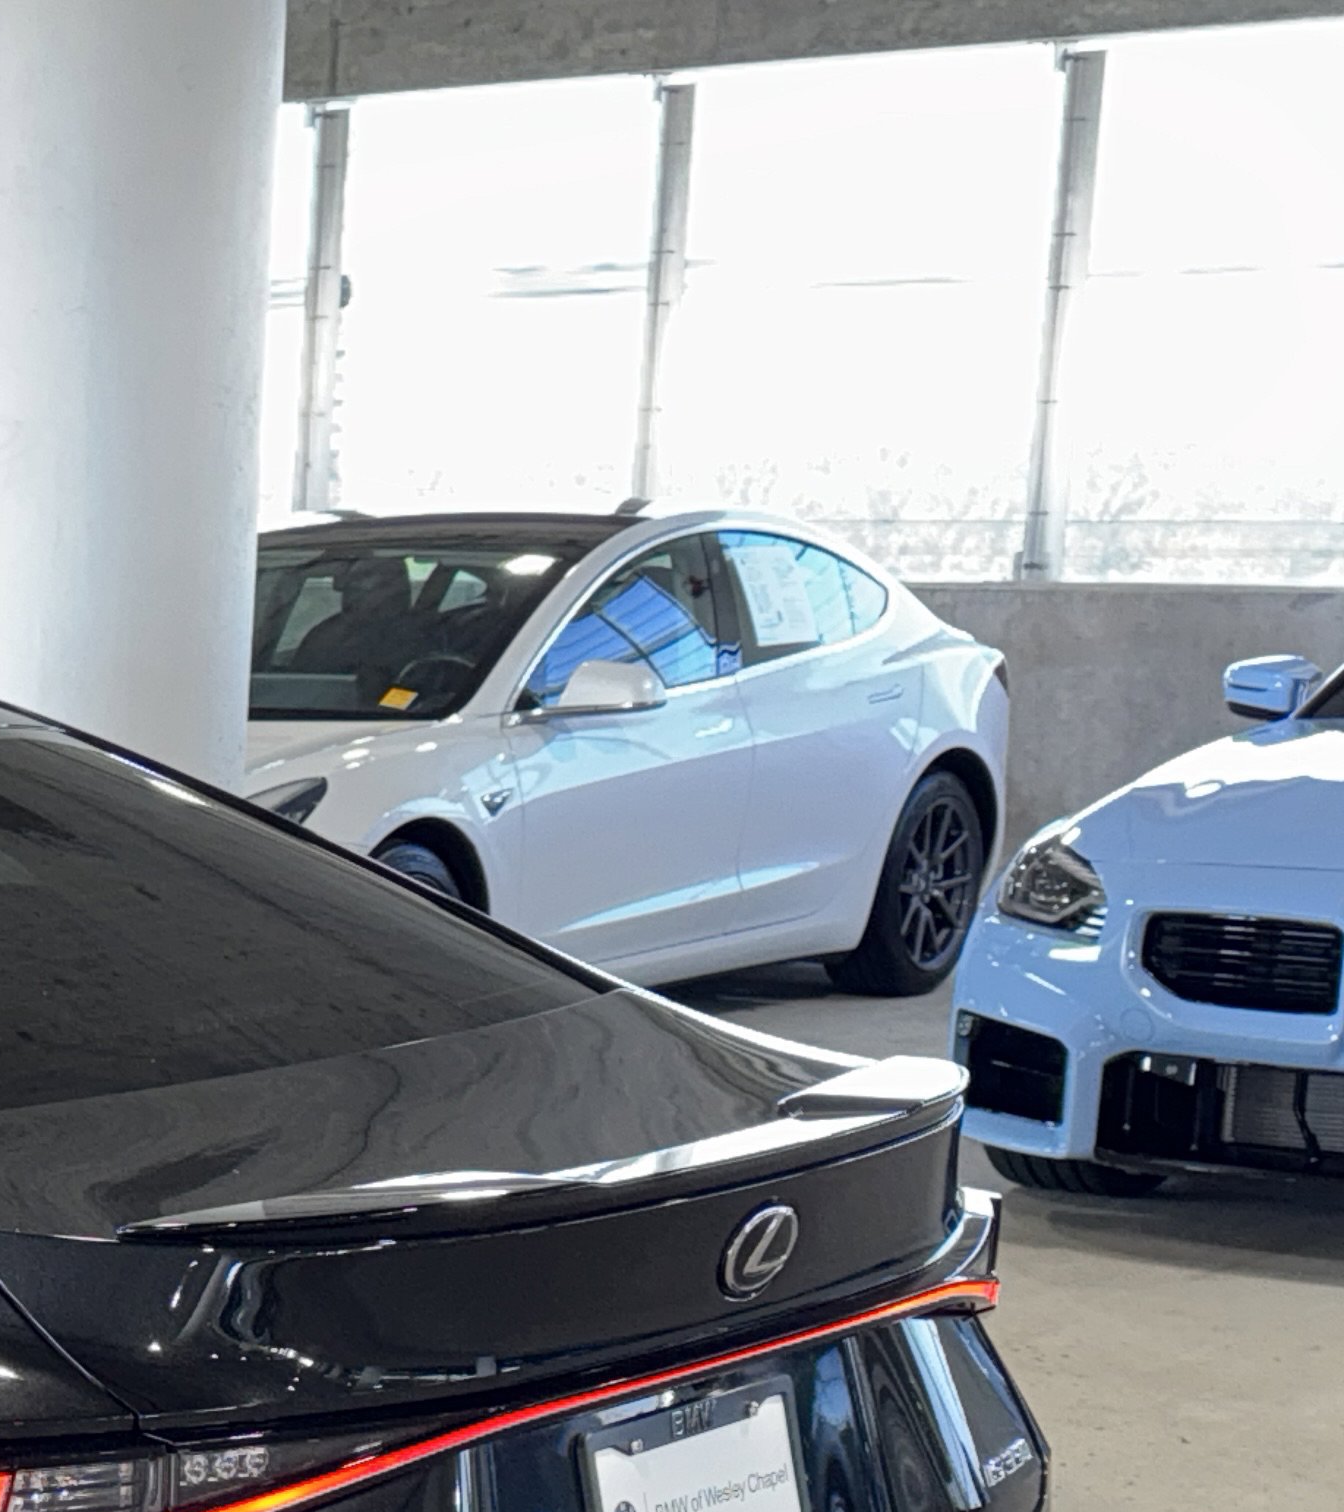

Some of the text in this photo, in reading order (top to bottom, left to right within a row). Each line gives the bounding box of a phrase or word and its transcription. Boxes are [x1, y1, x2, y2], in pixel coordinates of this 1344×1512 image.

[691, 1488, 704, 1512] of
[703, 1480, 746, 1502] Wesley
[747, 1463, 789, 1493] Chapel
